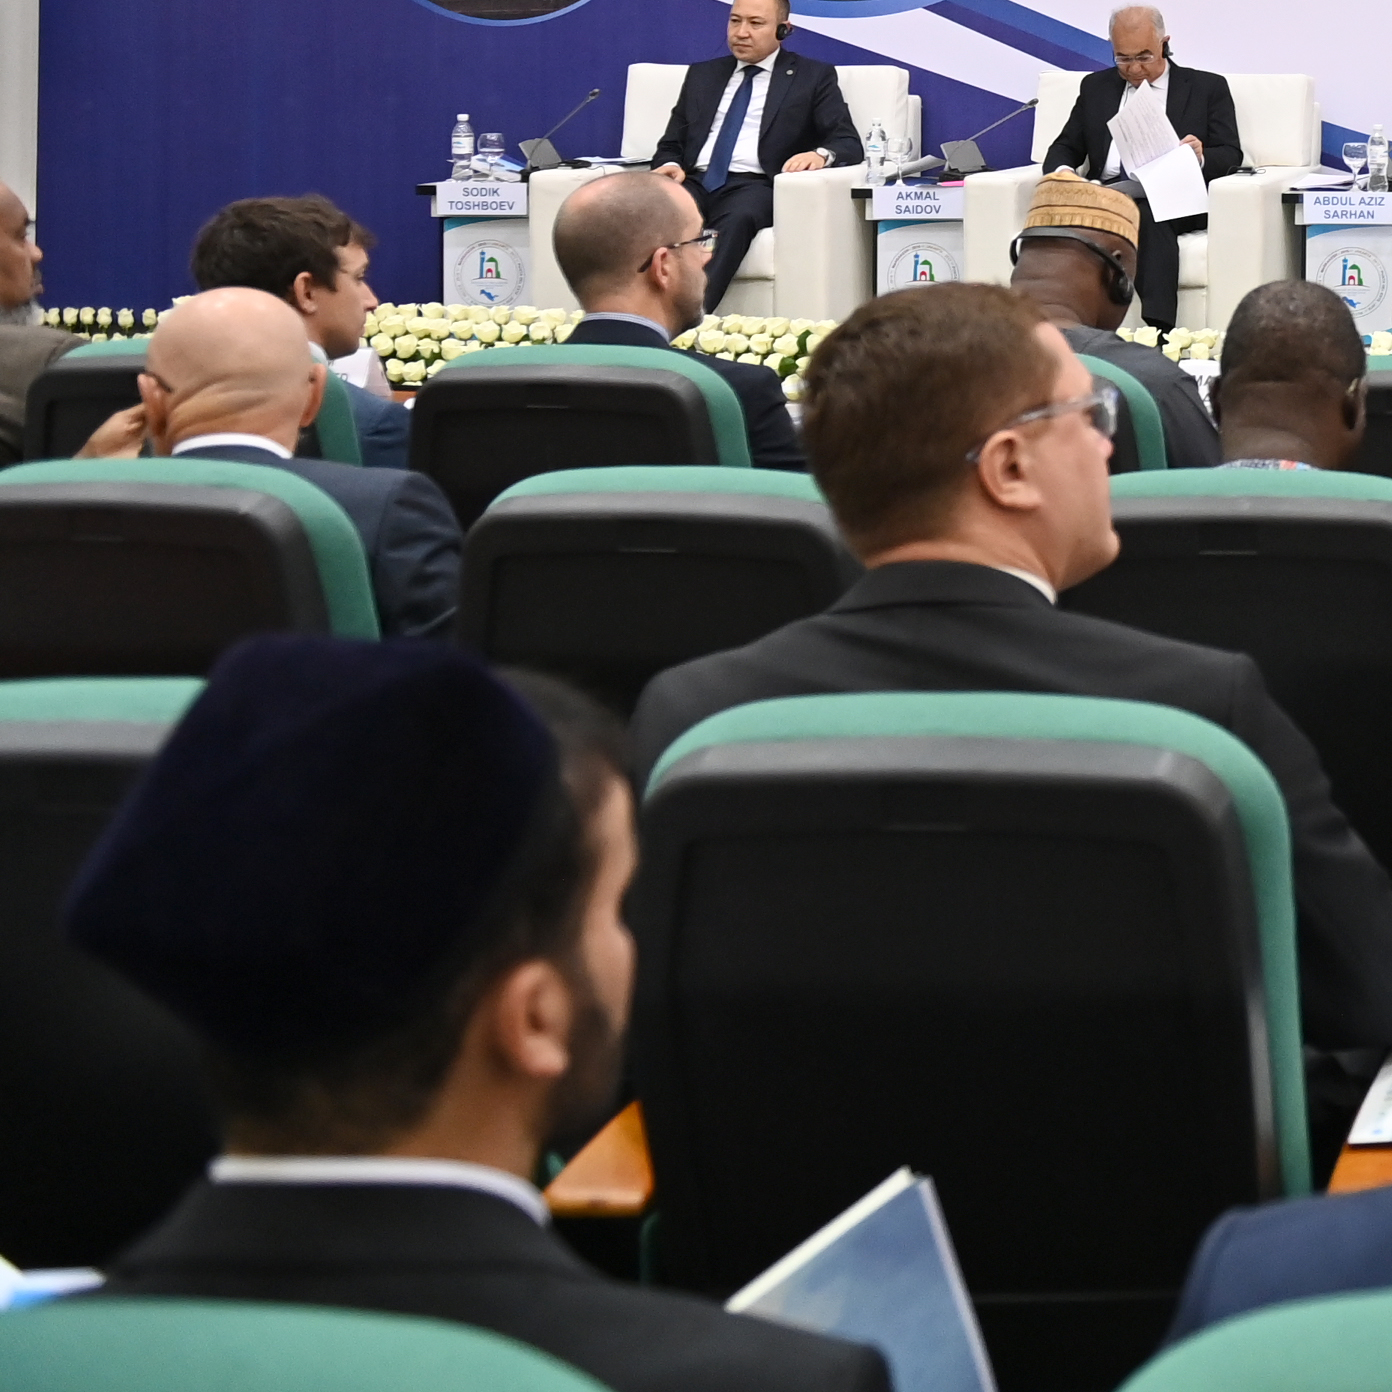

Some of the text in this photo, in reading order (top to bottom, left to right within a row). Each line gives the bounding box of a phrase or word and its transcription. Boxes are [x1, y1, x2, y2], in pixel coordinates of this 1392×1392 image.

[462, 188, 500, 197] SODIK
[896, 192, 940, 201] AKMAL
[448, 201, 515, 210] TOSHBOEV
[1314, 197, 1385, 206] ABDUL AZIZ
[895, 205, 941, 214] SAIDOV
[1324, 210, 1374, 219] SARHAN
